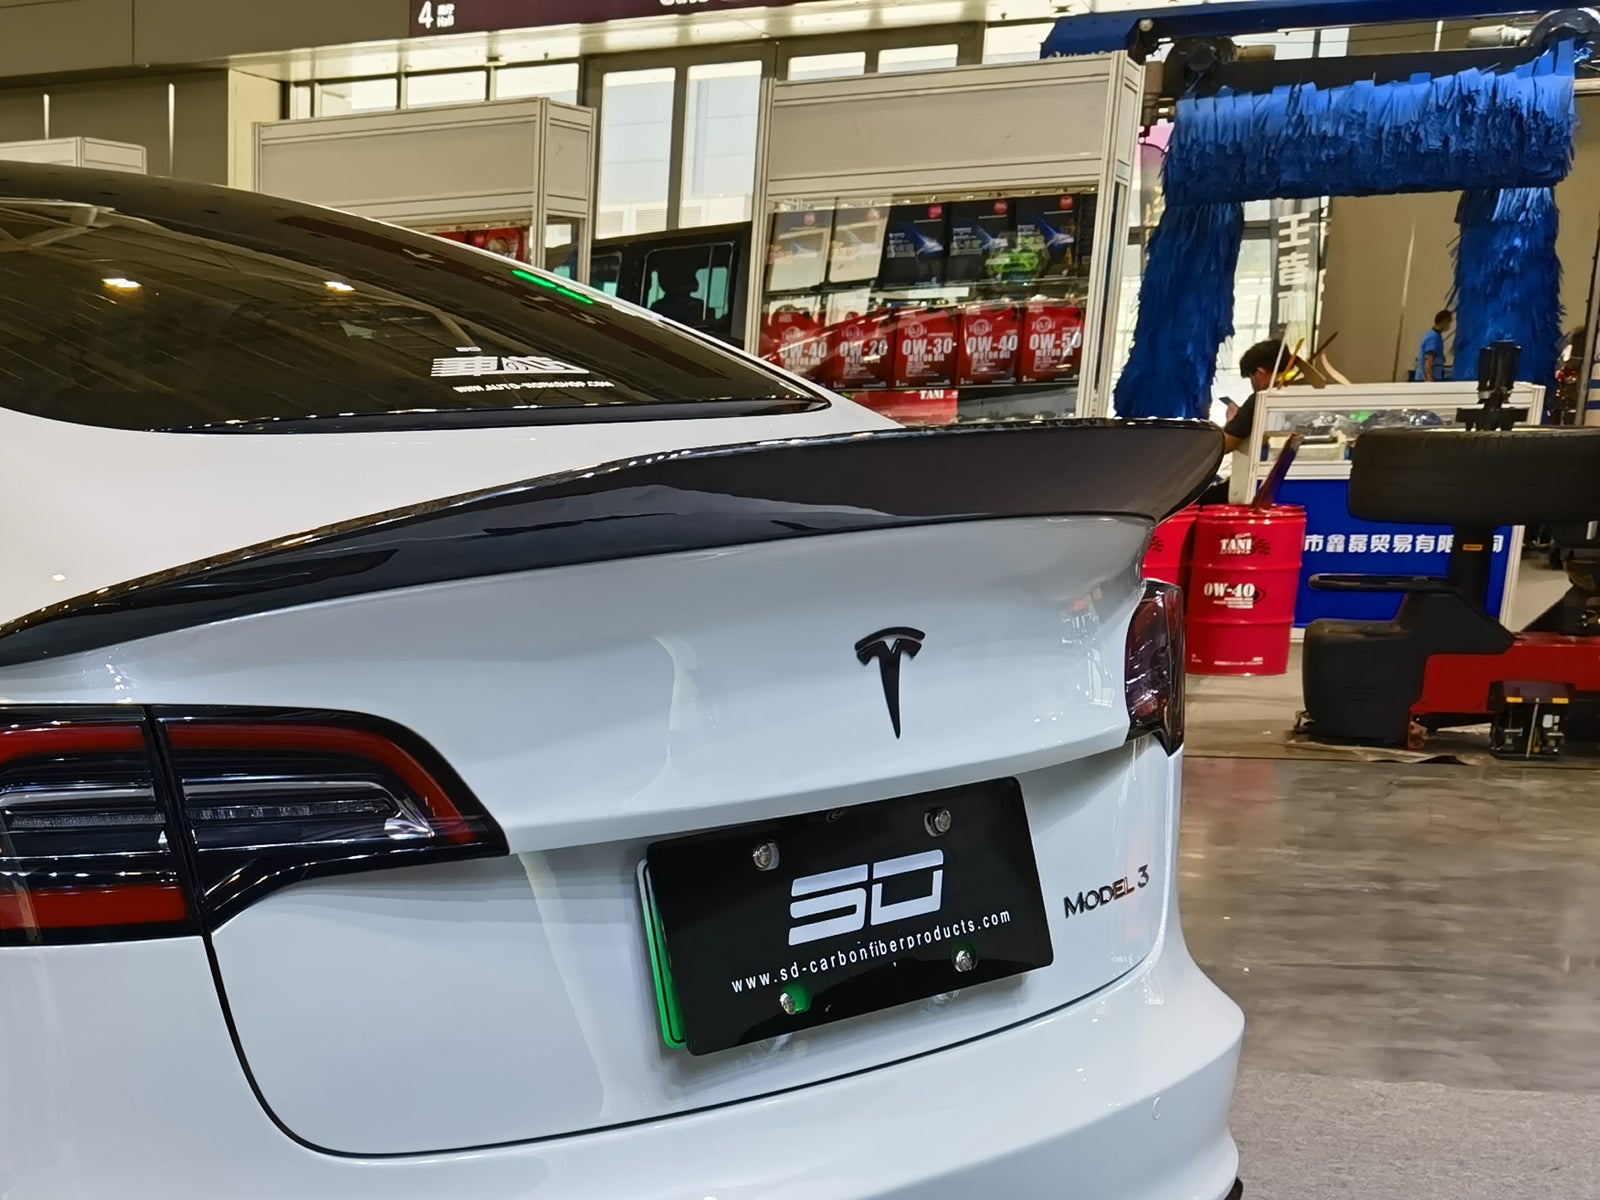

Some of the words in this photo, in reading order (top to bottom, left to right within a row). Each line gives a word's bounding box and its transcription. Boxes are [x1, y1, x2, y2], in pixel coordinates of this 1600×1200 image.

[418, 1, 434, 28] 4
[902, 337, 953, 356] 0W-30
[967, 334, 1018, 353] 0W-40
[1029, 332, 1082, 350] 0W-50
[919, 390, 945, 399] TANI
[1220, 538, 1252, 551] TANI
[1204, 583, 1255, 597] 0W-40
[788, 849, 944, 946] SD
[1063, 876, 1135, 919] MODEL
[1137, 864, 1150, 888] 3
[731, 909, 1012, 993] www.sd-carbonfiberproducts.com
